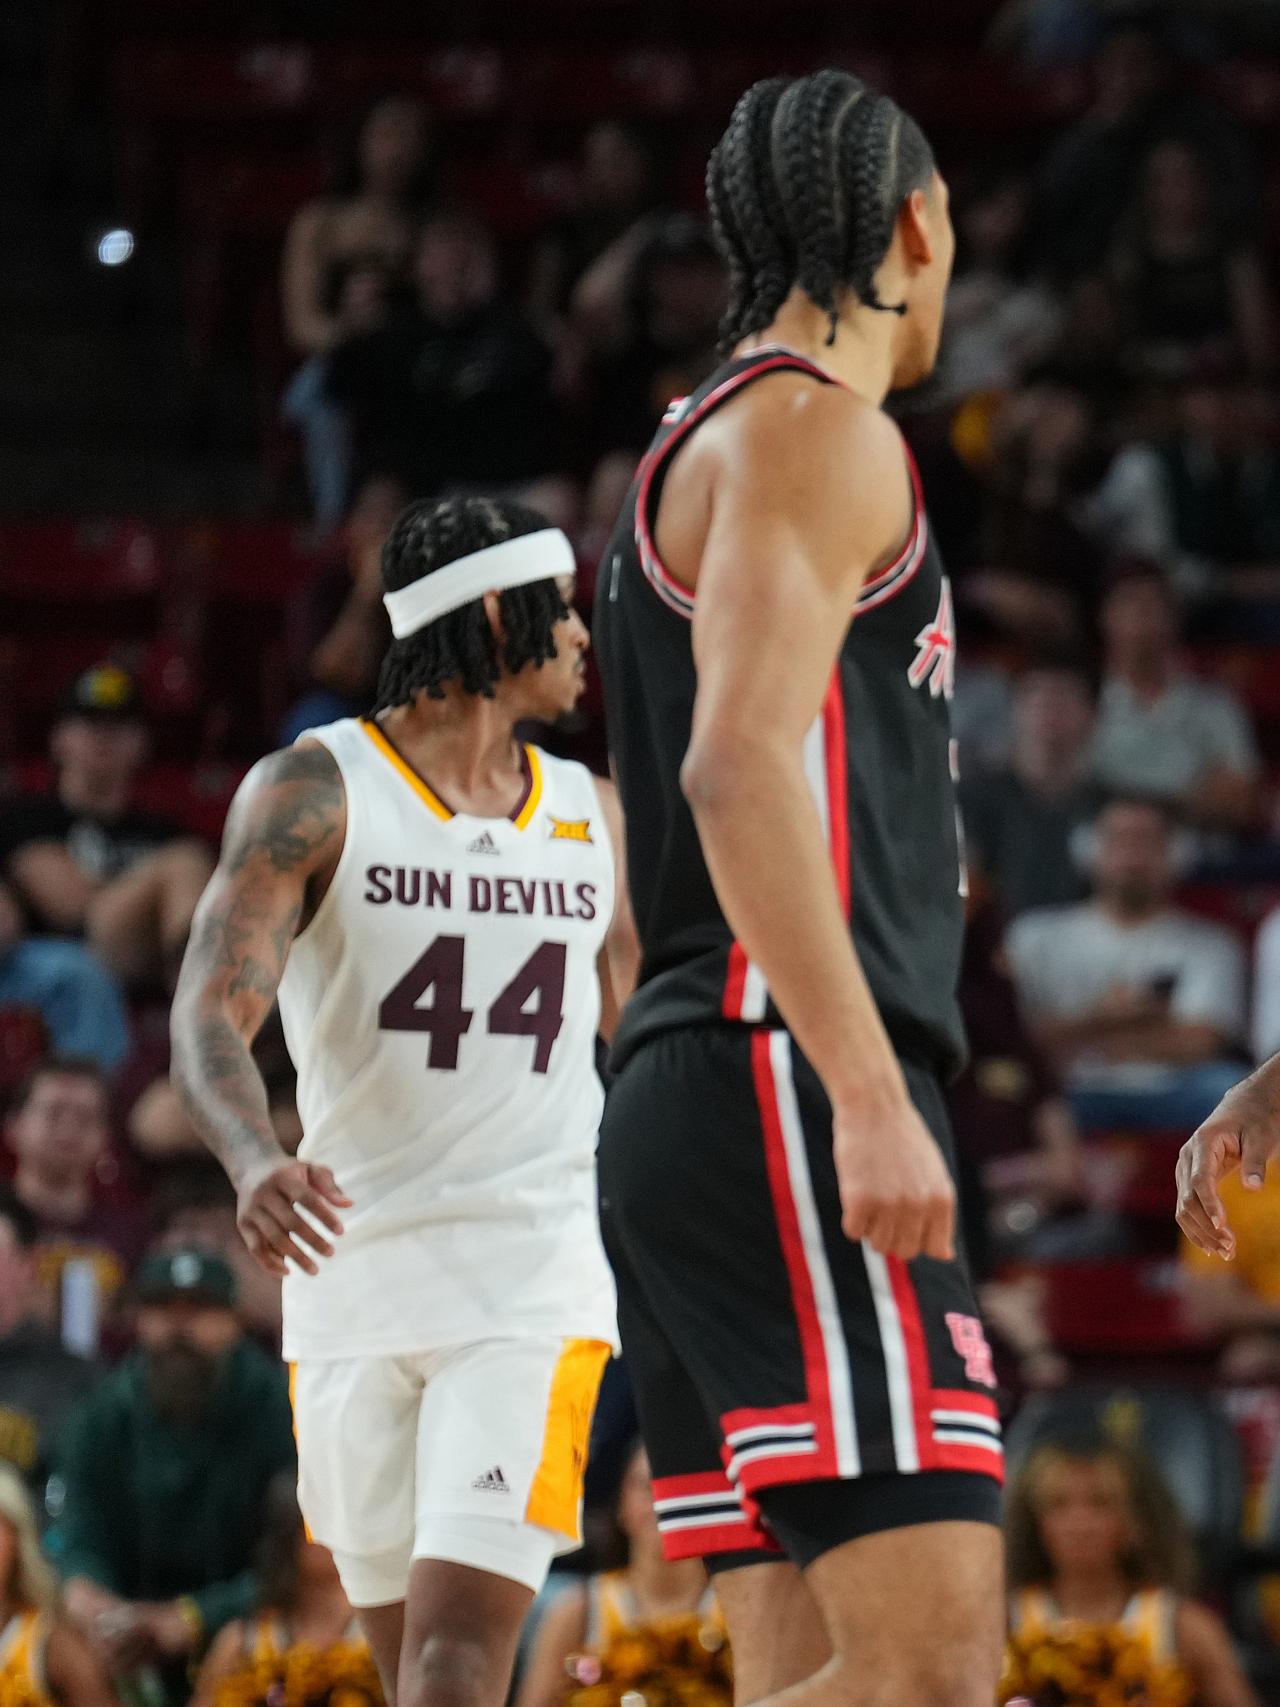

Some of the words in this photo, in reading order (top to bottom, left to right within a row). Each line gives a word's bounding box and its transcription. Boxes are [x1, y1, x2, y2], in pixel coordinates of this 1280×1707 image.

[364, 864, 452, 909] SUN
[468, 876, 597, 920] DEVILS
[378, 934, 569, 1075] 44
